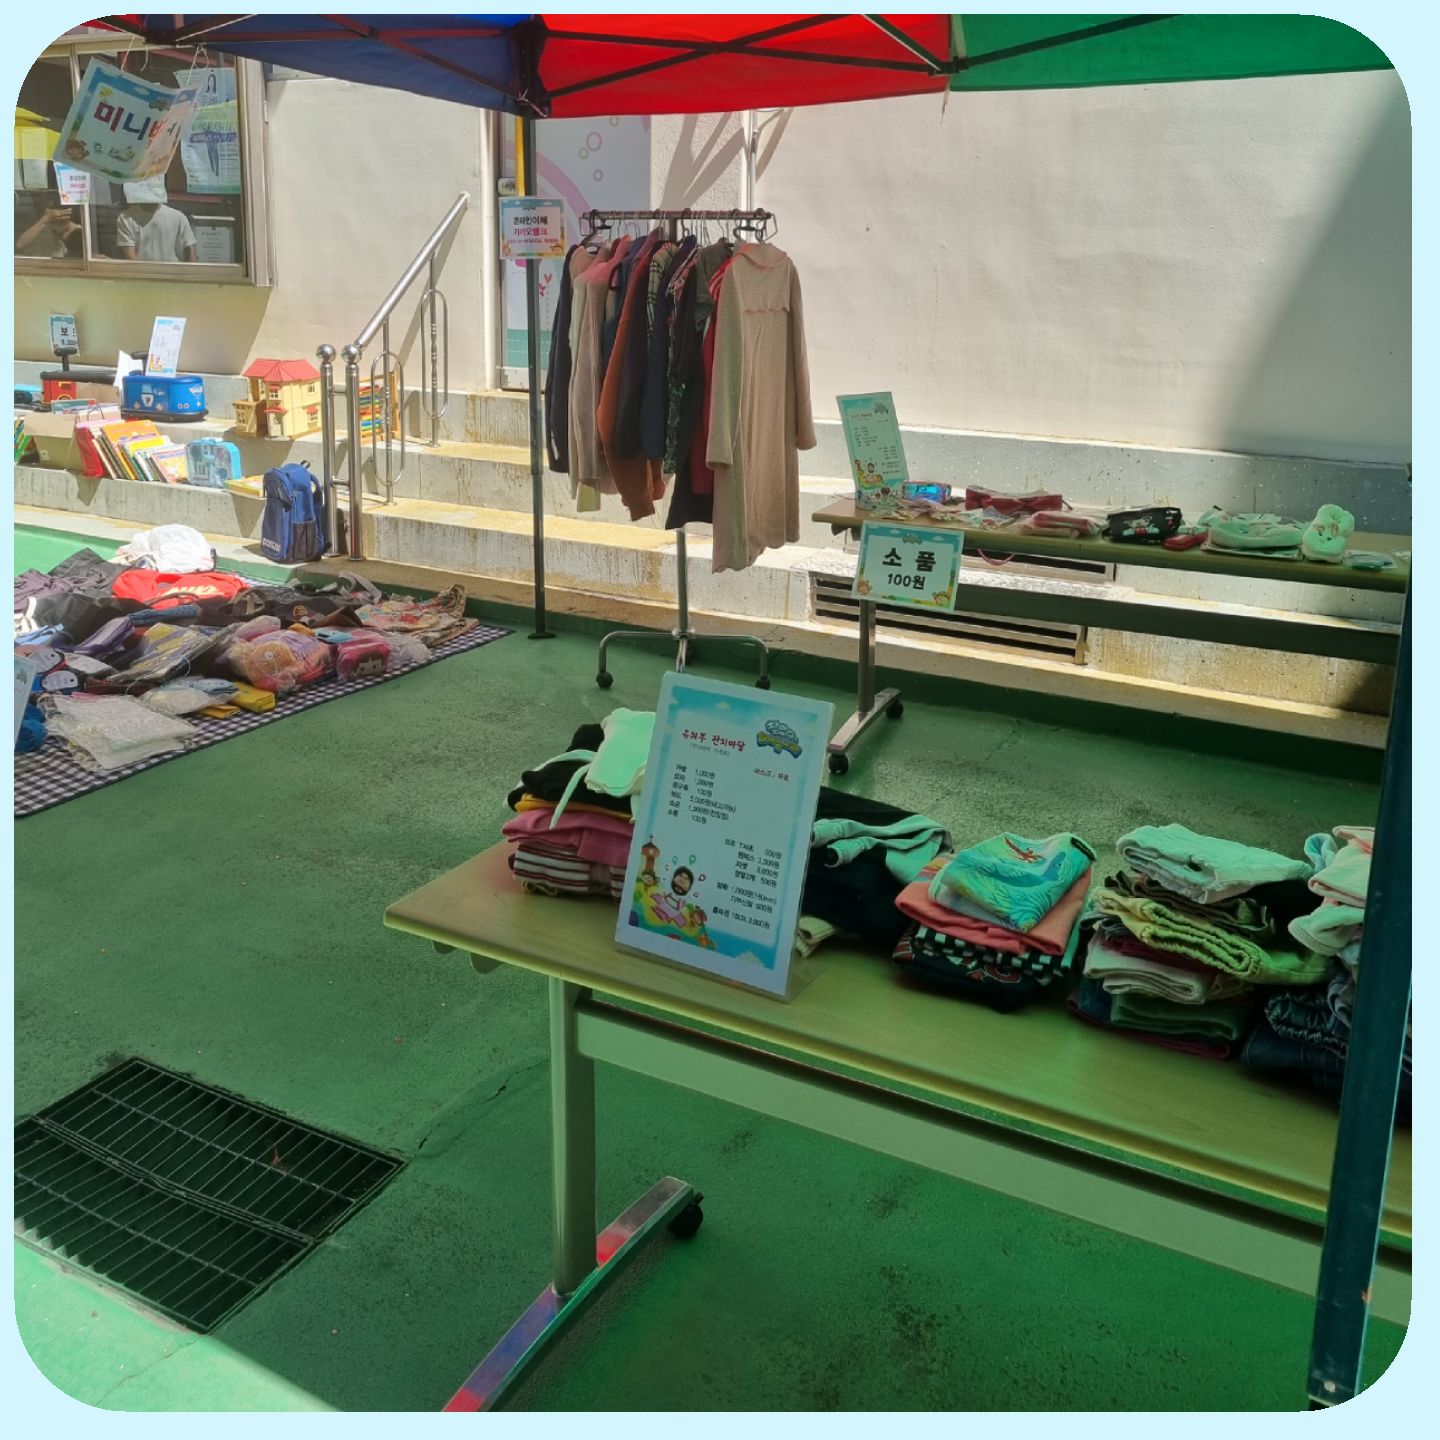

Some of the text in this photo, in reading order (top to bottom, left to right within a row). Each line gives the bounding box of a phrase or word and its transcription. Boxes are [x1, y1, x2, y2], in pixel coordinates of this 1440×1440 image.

[882, 547, 936, 573] 소 품
[887, 573, 926, 590] 100원
